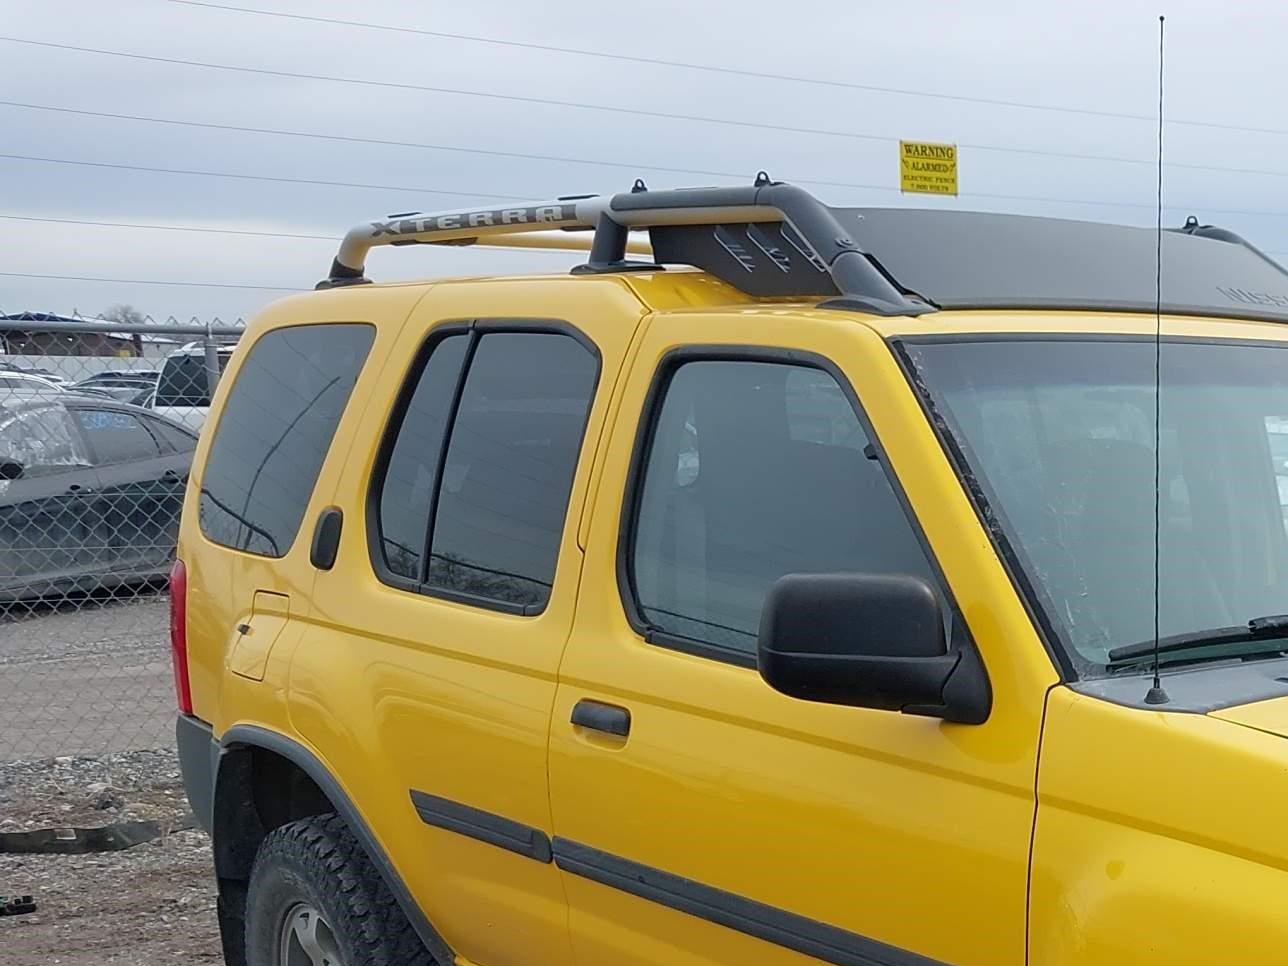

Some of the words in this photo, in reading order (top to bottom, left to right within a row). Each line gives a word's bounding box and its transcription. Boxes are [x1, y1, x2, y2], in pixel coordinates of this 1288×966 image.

[903, 143, 954, 159] WARNING
[911, 161, 949, 173] ALARMED
[369, 203, 563, 237] XTERRA
